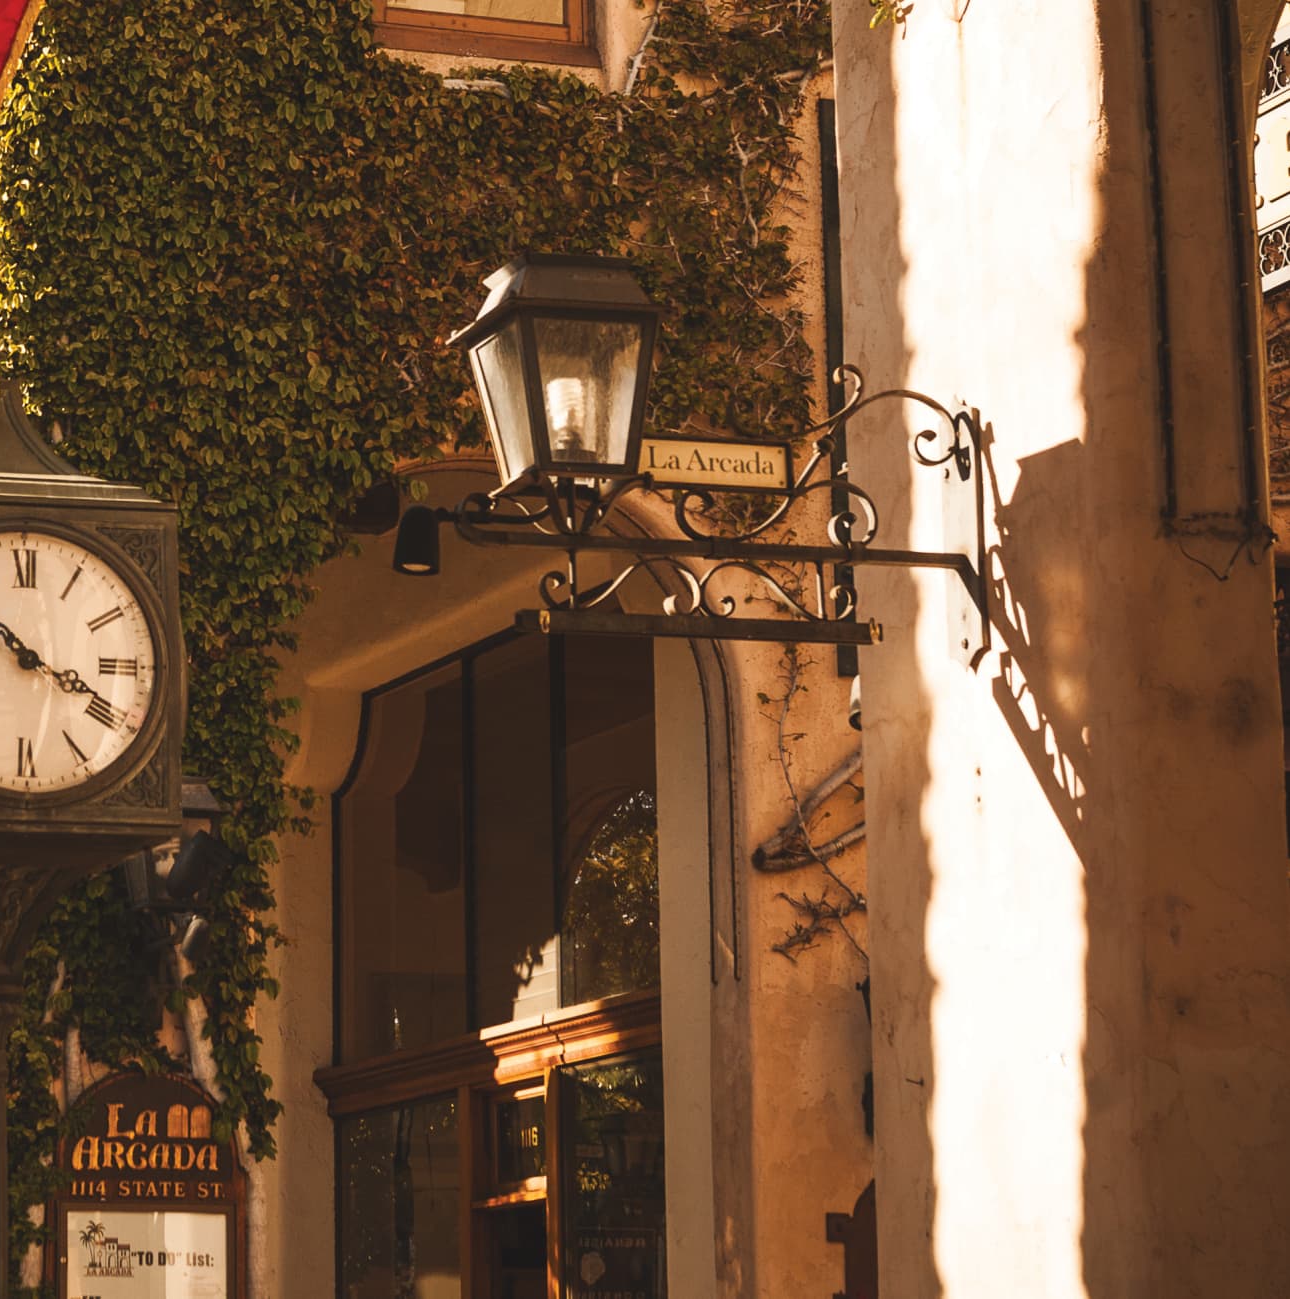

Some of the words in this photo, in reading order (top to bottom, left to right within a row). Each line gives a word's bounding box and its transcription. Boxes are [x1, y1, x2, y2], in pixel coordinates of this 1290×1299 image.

[647, 445, 681, 471] La
[686, 448, 775, 475] Arcada
[11, 548, 38, 590] XII
[58, 564, 84, 602] I
[86, 604, 125, 635] II
[98, 655, 137, 680] III
[15, 736, 39, 778] VI
[62, 729, 90, 768] V
[71, 1180, 107, 1196] 1114
[118, 1180, 186, 1197] STATE
[197, 1181, 226, 1198] ST.
[186, 1251, 214, 1267] List:
